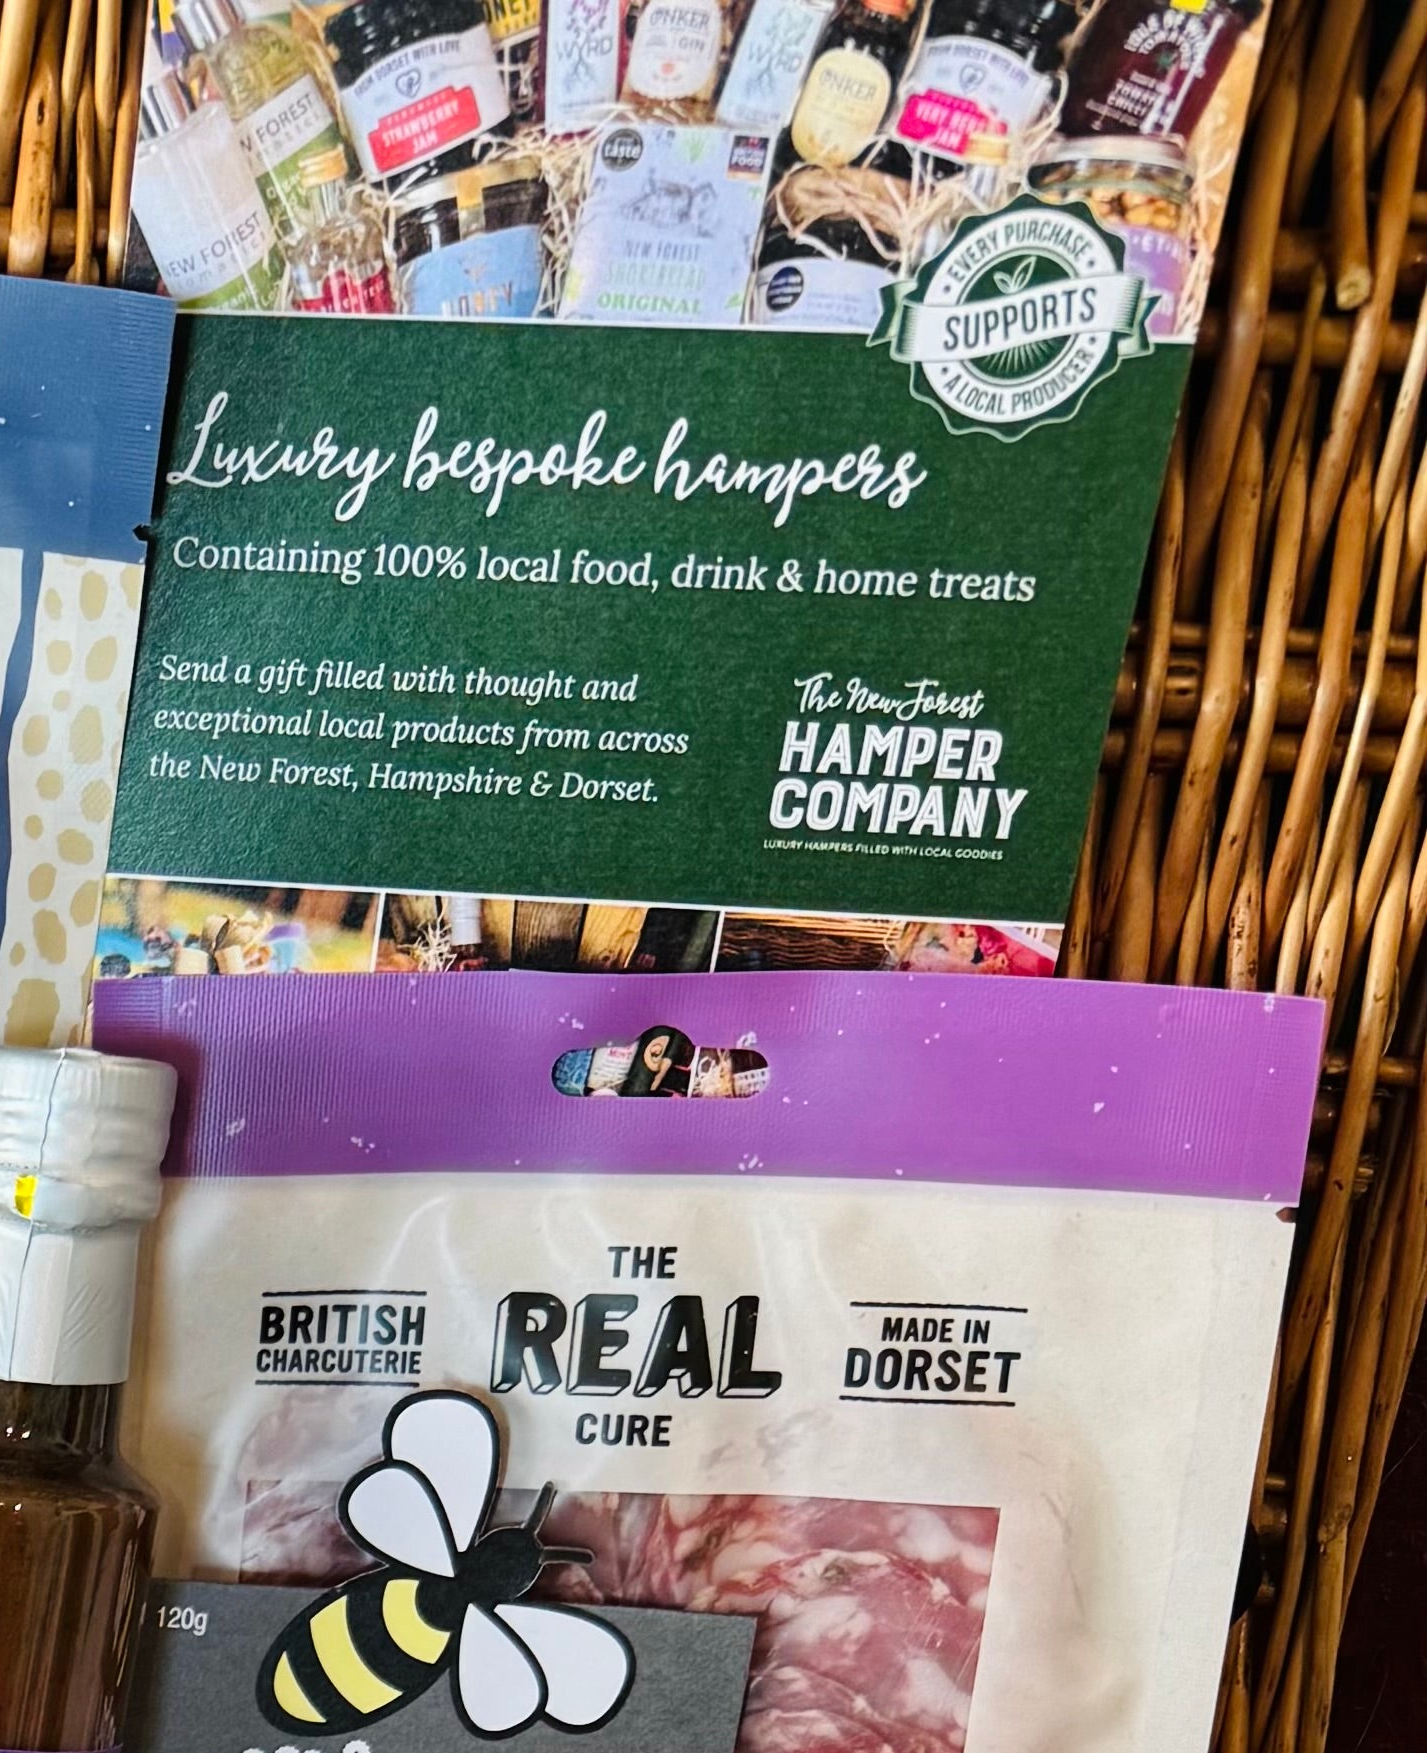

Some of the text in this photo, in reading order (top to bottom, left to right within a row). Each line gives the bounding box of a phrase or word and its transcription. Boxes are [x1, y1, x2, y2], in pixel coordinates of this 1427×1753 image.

[944, 287, 1099, 351] SUPPORTS
[166, 389, 928, 527] Luxury bespoke hampers
[172, 536, 1036, 603] Containing 100% local food, drink & home treats
[159, 653, 638, 711] Send a gift filled with thought and
[779, 721, 1002, 781] HAMPER
[769, 778, 1028, 839] COMPANY
[607, 1245, 678, 1280] THE
[259, 1303, 426, 1347] BRITISH
[490, 1291, 783, 1397] REAL
[880, 1316, 990, 1346] MADE IN
[255, 1348, 421, 1375] CHARCUTERIE
[842, 1348, 1021, 1394] DORSET
[574, 1413, 672, 1448] CURE
[156, 1606, 208, 1636] 120g
